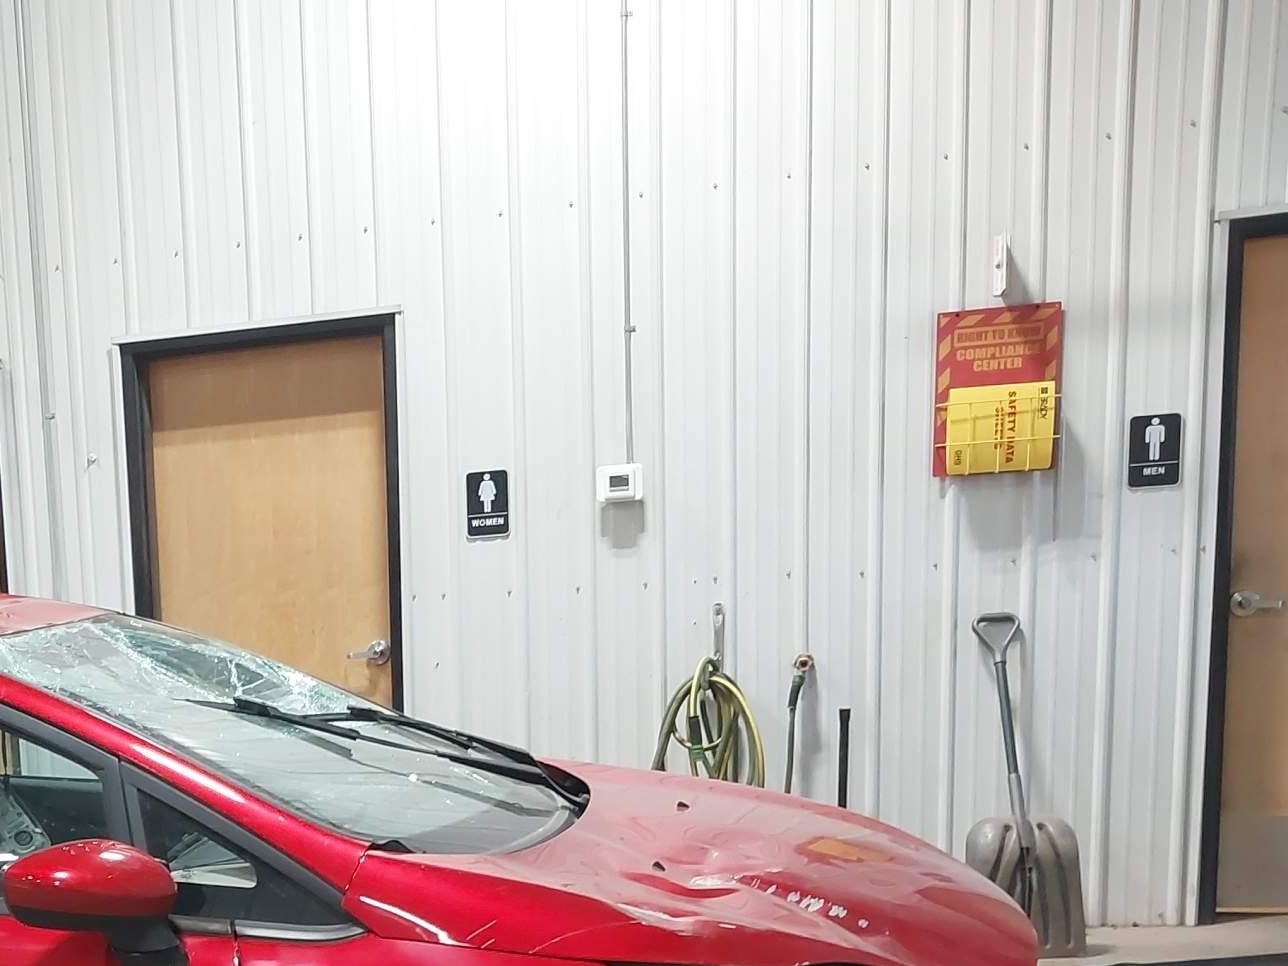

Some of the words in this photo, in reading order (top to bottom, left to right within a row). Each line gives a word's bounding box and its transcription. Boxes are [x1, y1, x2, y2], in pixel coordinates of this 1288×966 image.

[957, 343, 1040, 360] COMPLIANCE
[973, 357, 1022, 372] CENTER
[1007, 391, 1016, 432] SAFETY
[1005, 436, 1015, 464] DATA
[1143, 466, 1165, 476] MEN
[472, 517, 504, 527] WOMEN
